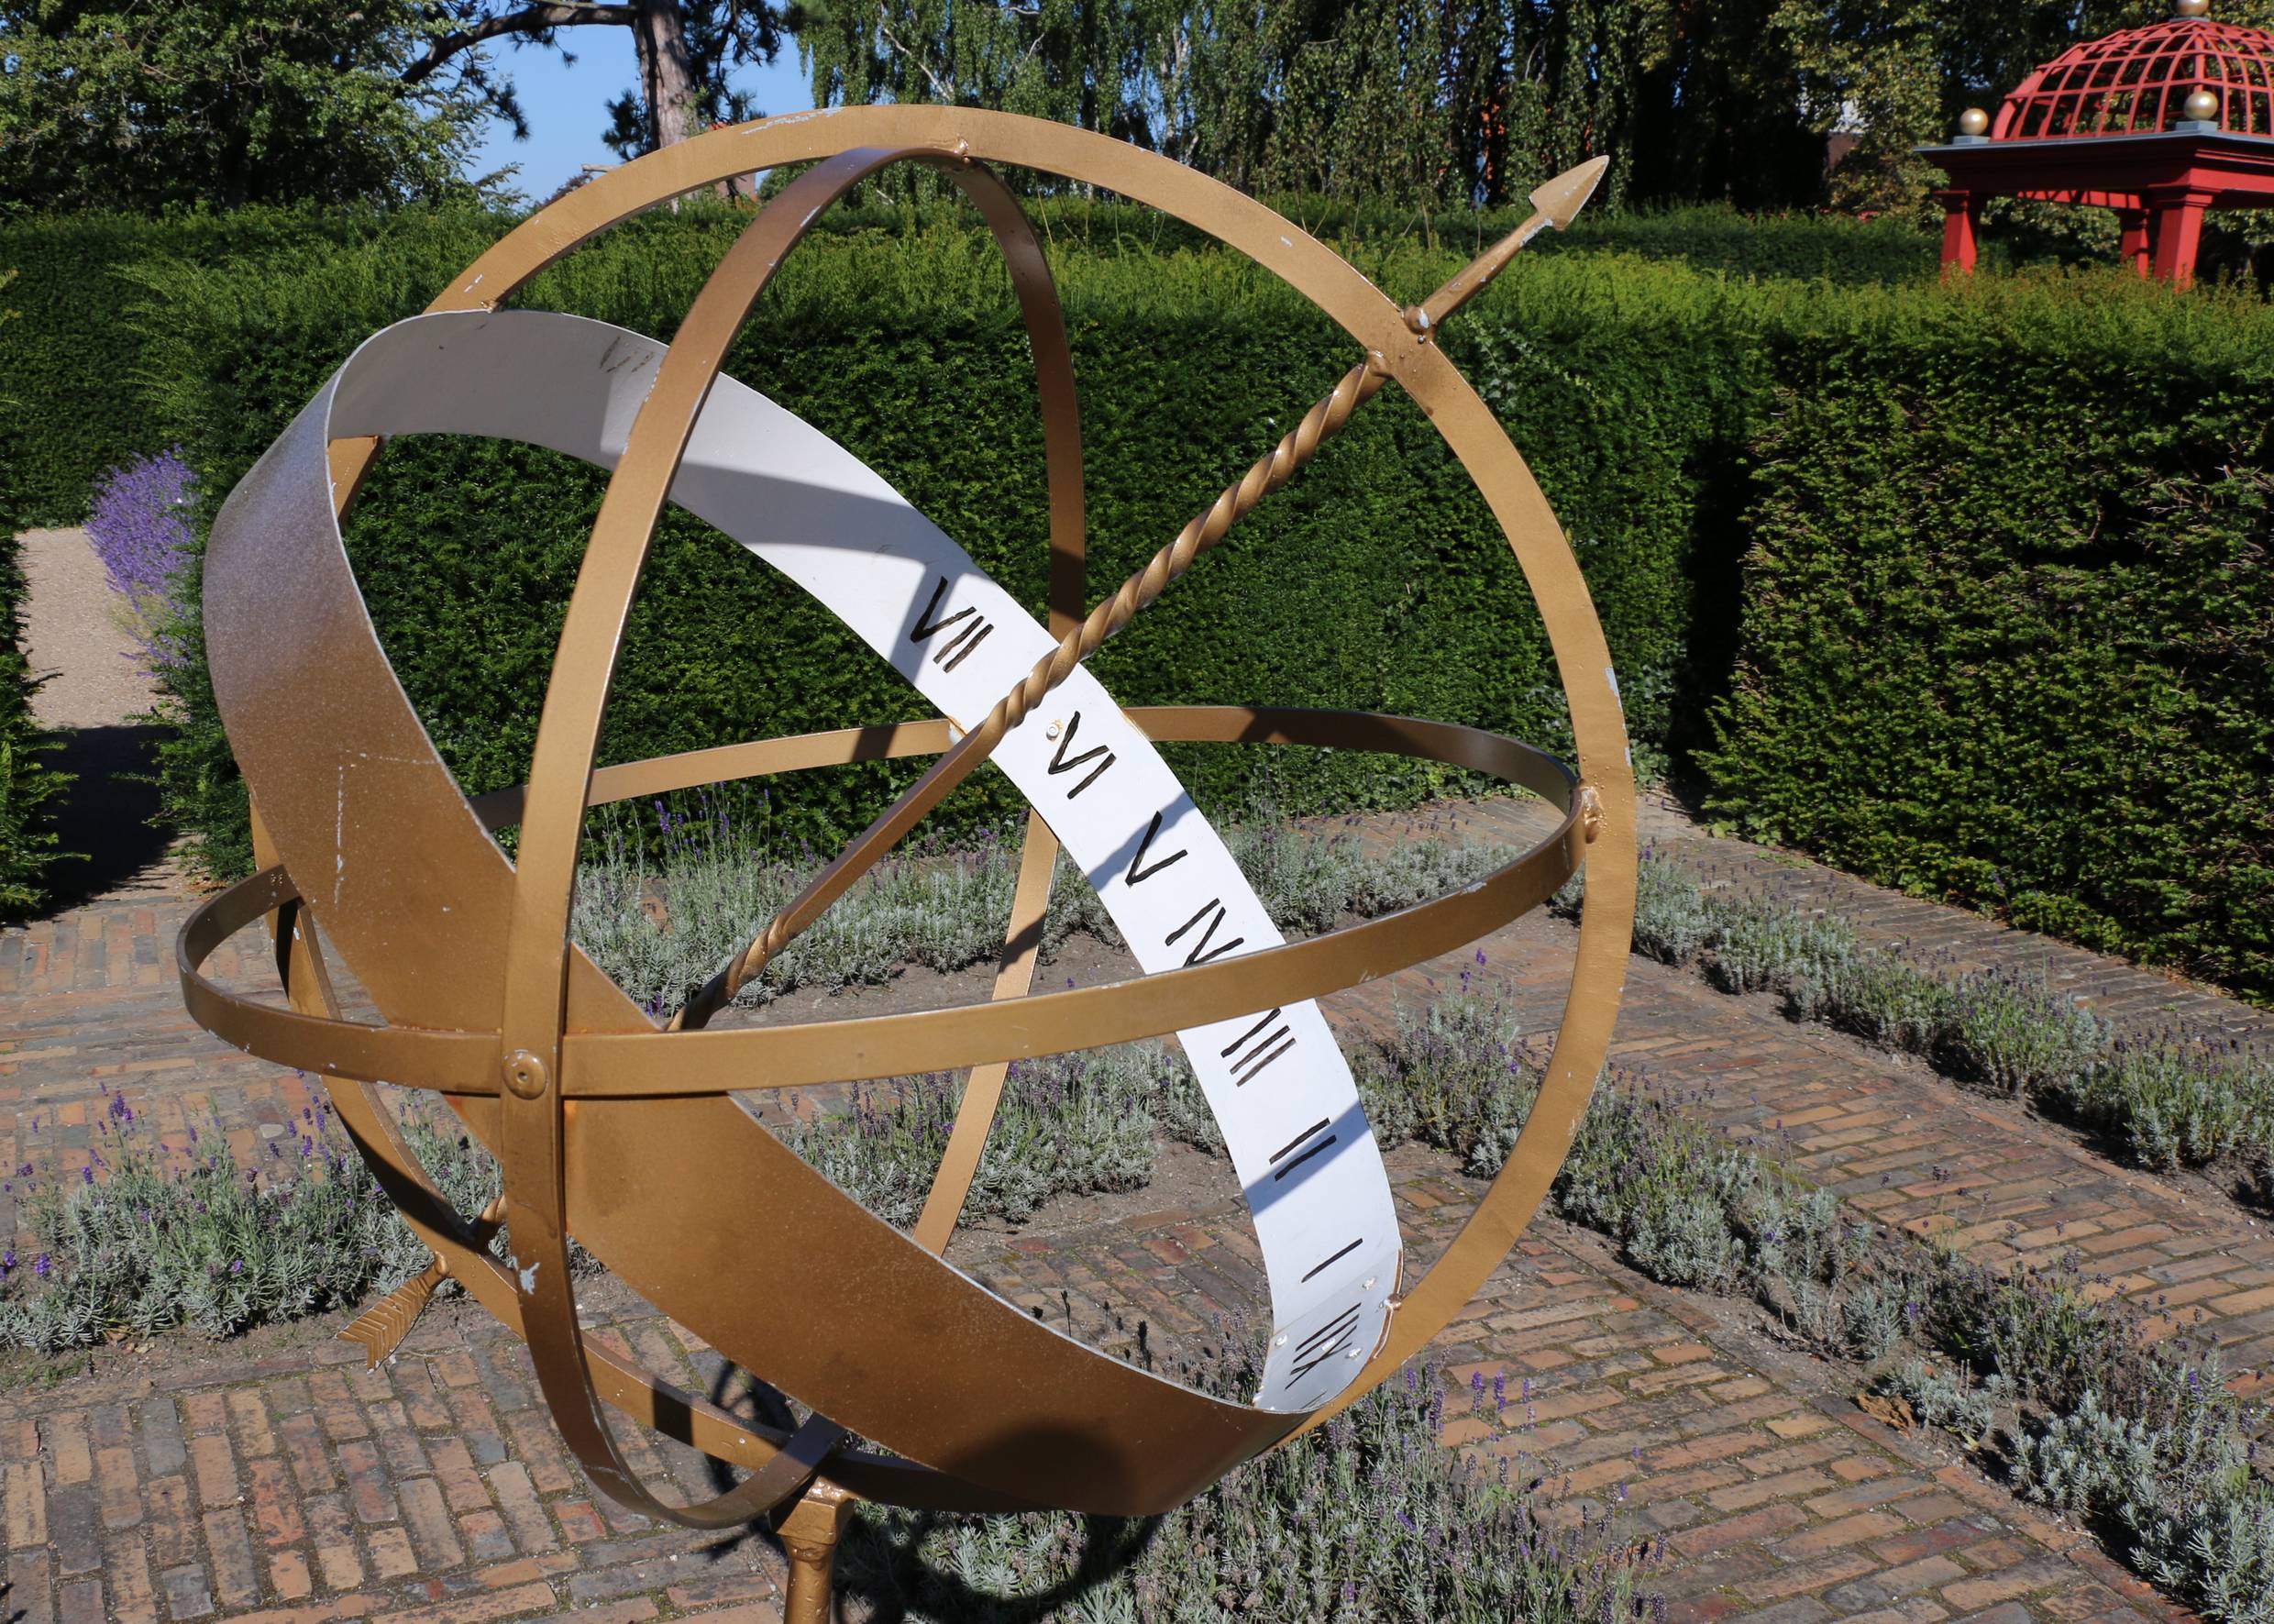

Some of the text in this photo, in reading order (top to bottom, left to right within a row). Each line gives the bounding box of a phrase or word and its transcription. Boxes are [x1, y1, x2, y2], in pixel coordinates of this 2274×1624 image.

[910, 576, 994, 673] VII
[1048, 711, 1117, 800] VI
[1125, 811, 1188, 887] V
[1165, 898, 1244, 967] IV
[1220, 1008, 1296, 1087] III
[1269, 1117, 1337, 1182] II
[1301, 1238, 1363, 1284] I
